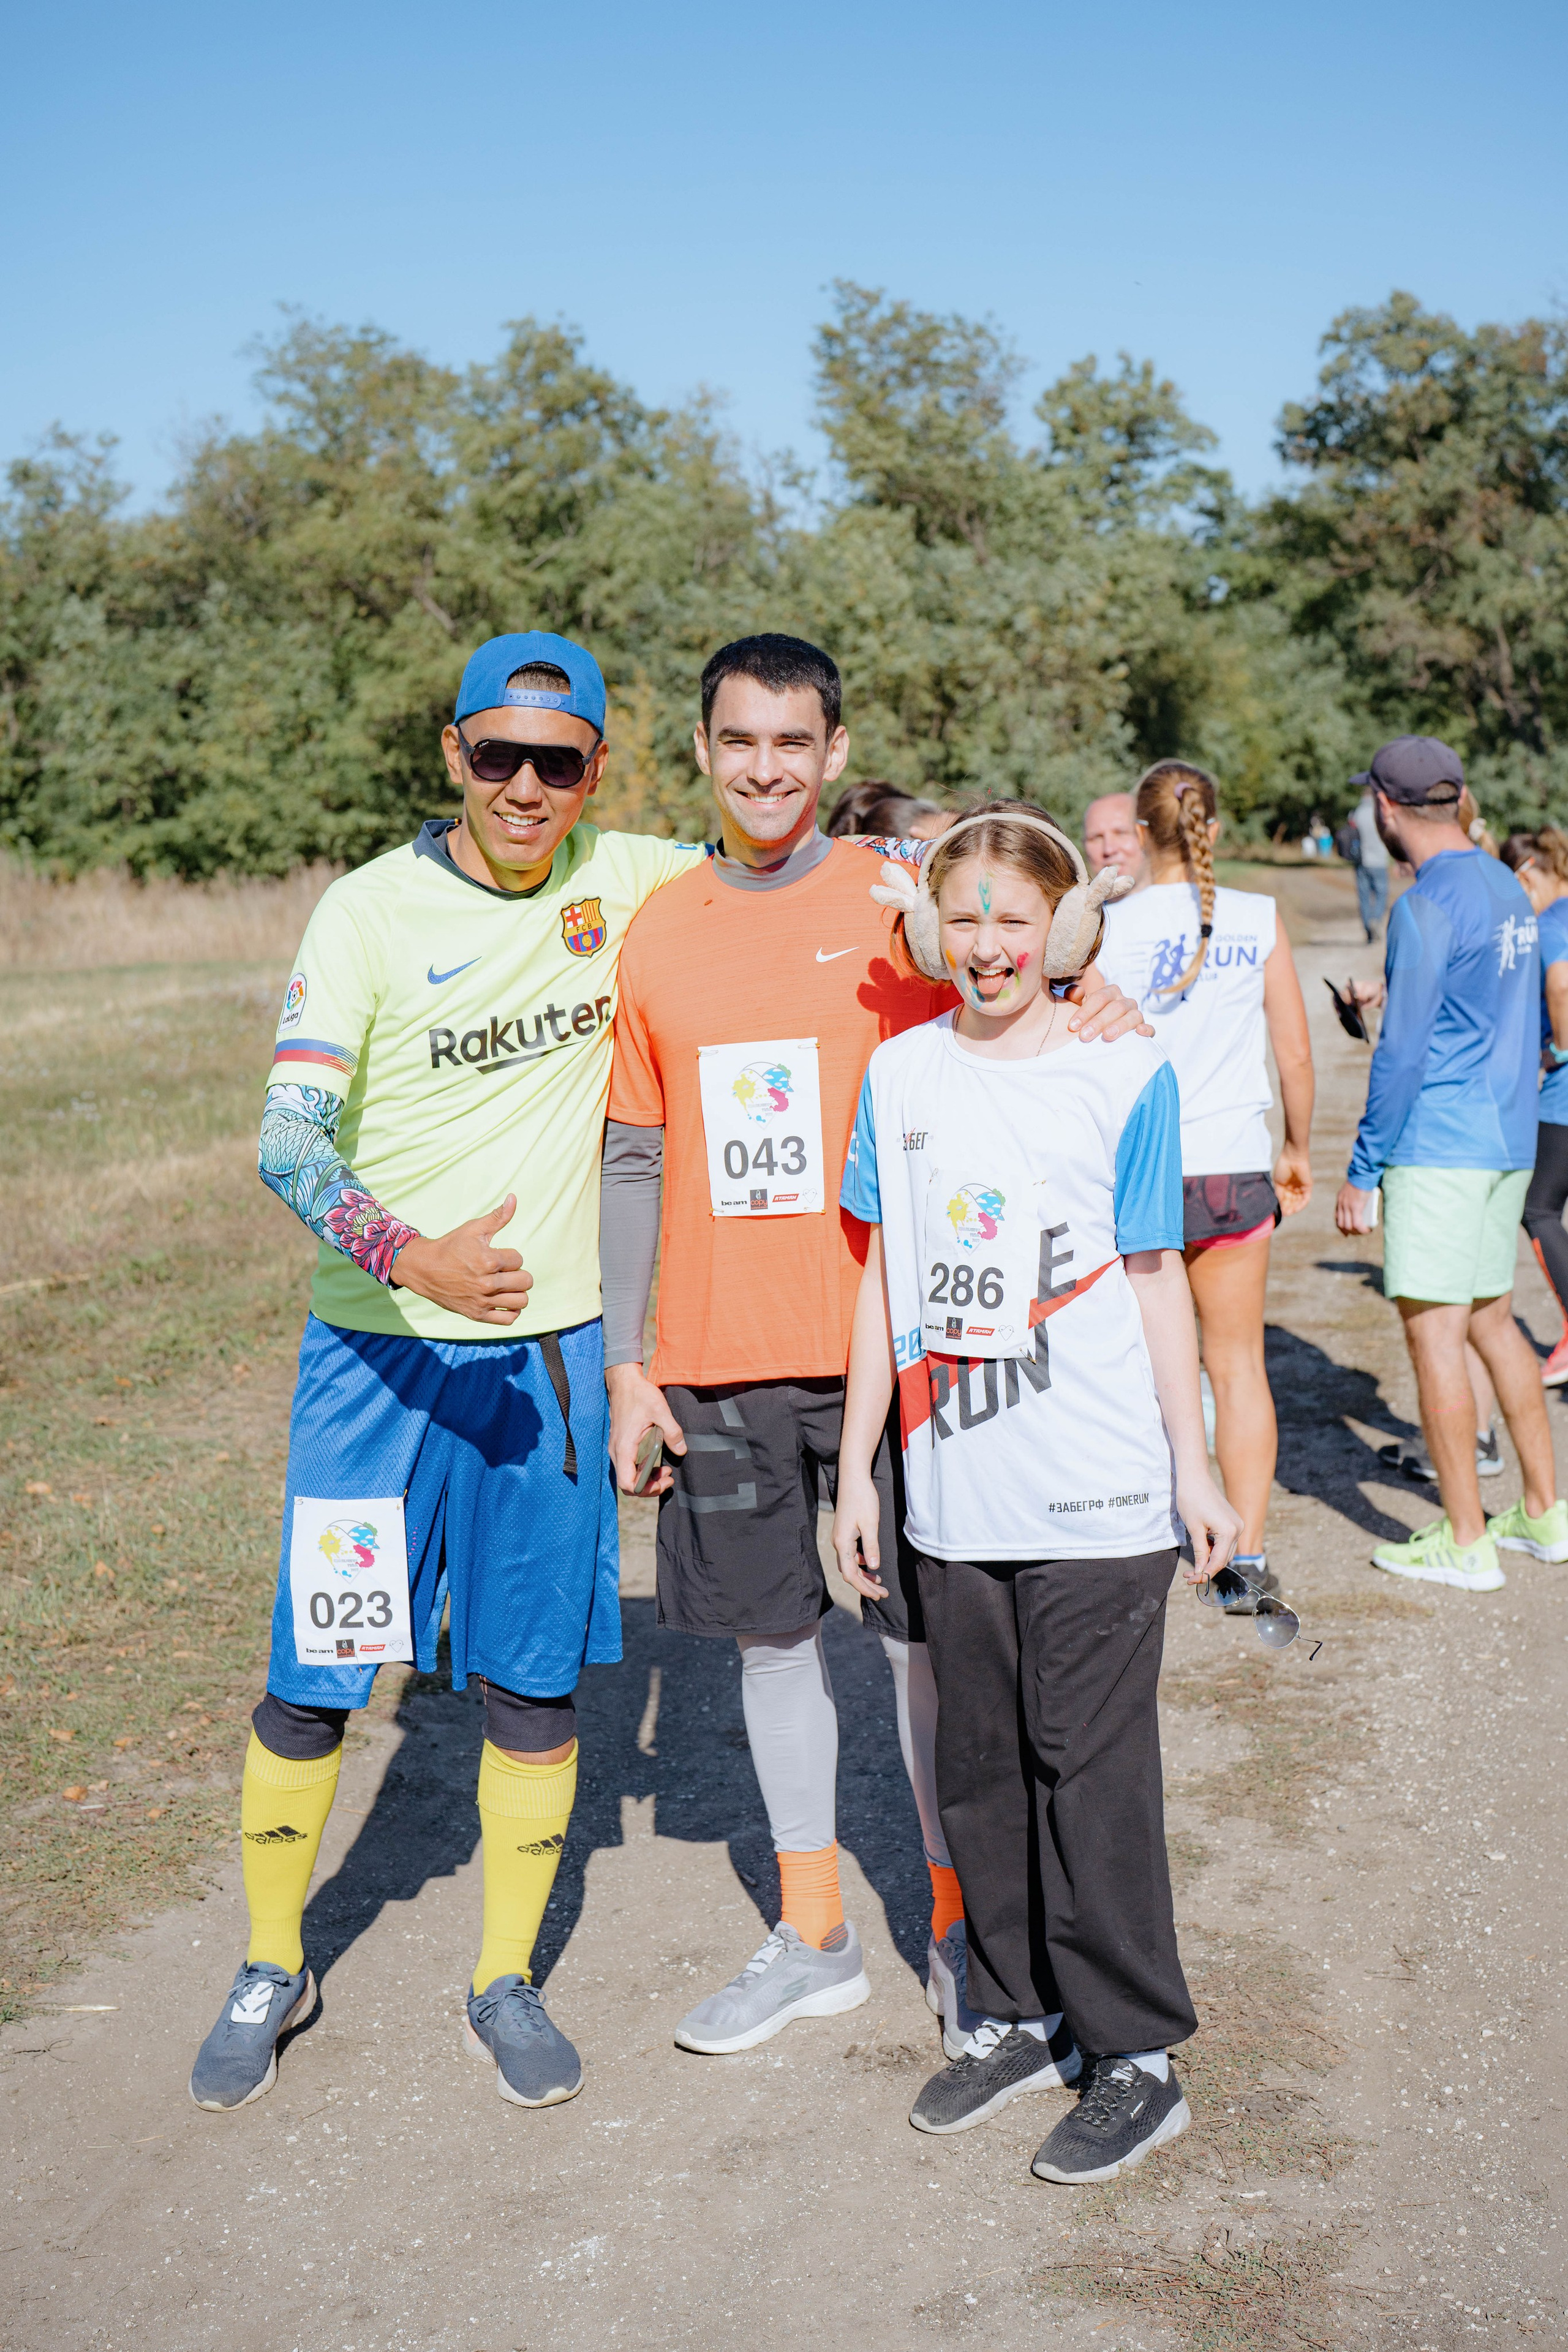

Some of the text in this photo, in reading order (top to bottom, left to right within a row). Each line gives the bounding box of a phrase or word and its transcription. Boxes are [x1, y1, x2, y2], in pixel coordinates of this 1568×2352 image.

[576, 922, 592, 933] FCB
[282, 1012, 299, 1024] LaLiga
[429, 995, 611, 1069] Rakuten
[724, 1136, 807, 1180] 043
[928, 1262, 1003, 1308] 286
[946, 1328, 962, 1336] copy
[1049, 1493, 1149, 1513] #ЗАБЕГРФ #ONERUN
[310, 1591, 393, 1629] 023
[517, 1844, 563, 1856] adida
